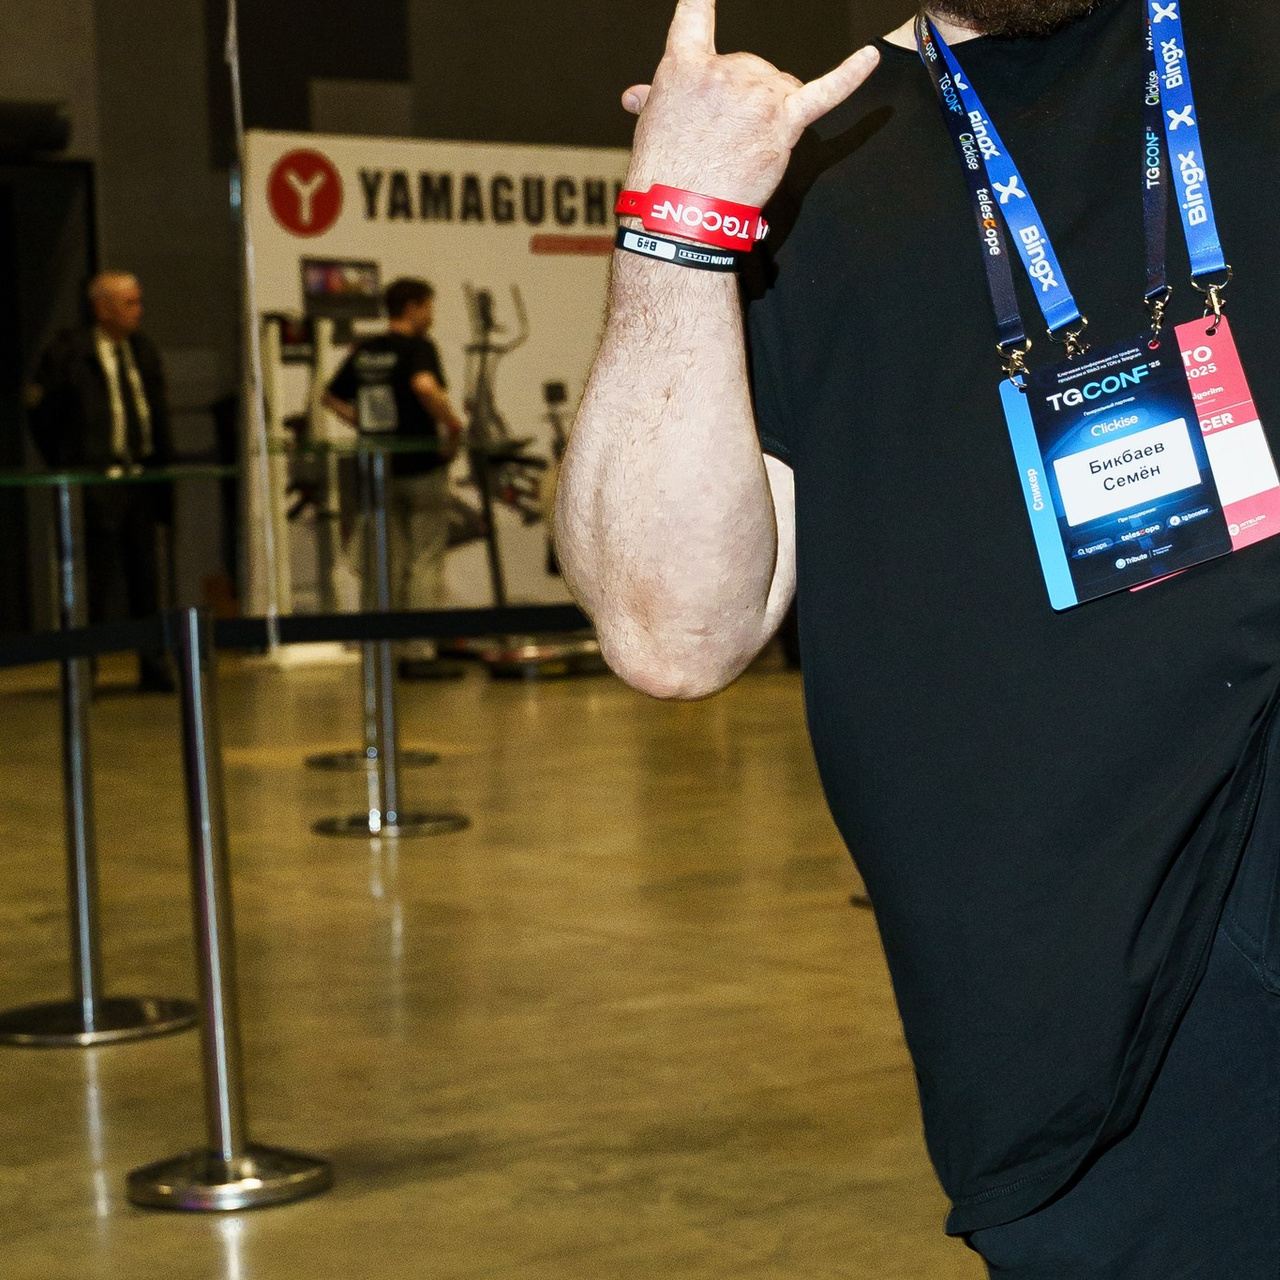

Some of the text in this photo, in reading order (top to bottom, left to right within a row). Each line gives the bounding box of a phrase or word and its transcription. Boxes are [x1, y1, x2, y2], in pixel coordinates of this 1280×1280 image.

[939, 73, 962, 113] TGCONF
[958, 133, 980, 170] Clickise
[1146, 132, 1161, 190] TGCONF
[358, 169, 622, 227] YAMAGUCH
[651, 200, 750, 239] TGCONF
[976, 187, 1001, 256] telescope
[636, 237, 658, 252] B#9
[1046, 364, 1149, 411] TGCONF
[1091, 415, 1138, 437] Clickise
[1089, 442, 1165, 475] Бикбаев
[1103, 465, 1161, 491] Семён
[1027, 468, 1044, 511] Спикер
[1121, 524, 1160, 541] telescope
